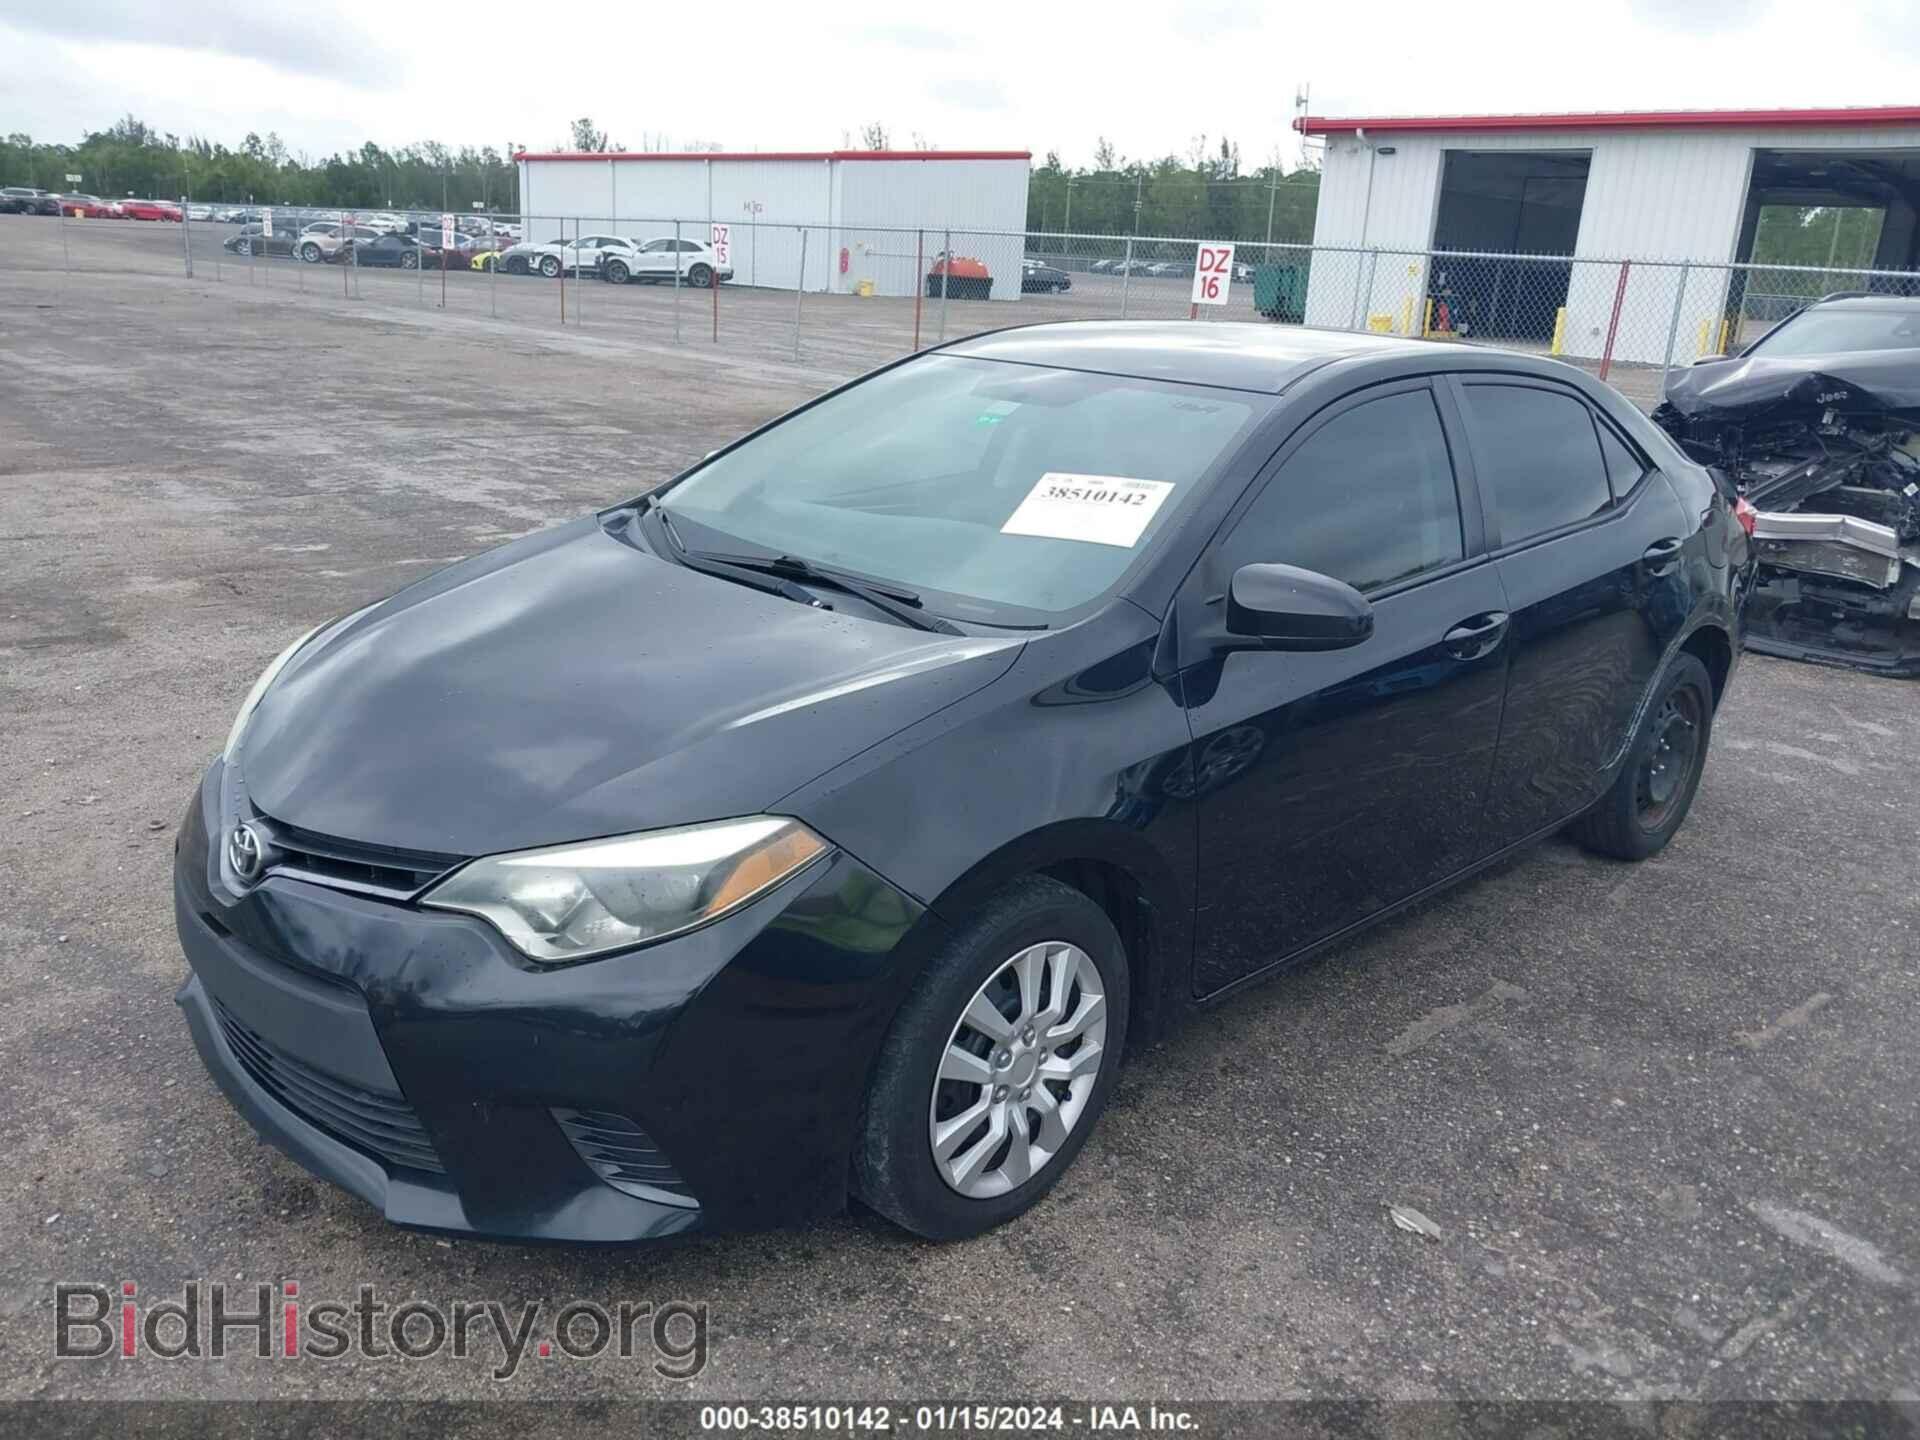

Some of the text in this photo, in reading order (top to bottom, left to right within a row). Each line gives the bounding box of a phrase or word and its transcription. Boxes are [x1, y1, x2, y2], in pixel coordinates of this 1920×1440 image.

[712, 226, 729, 245] DZ
[716, 247, 727, 264] 15
[1199, 248, 1231, 273] DZ
[1200, 275, 1219, 299] 16
[1041, 486, 1148, 507] 38510142
